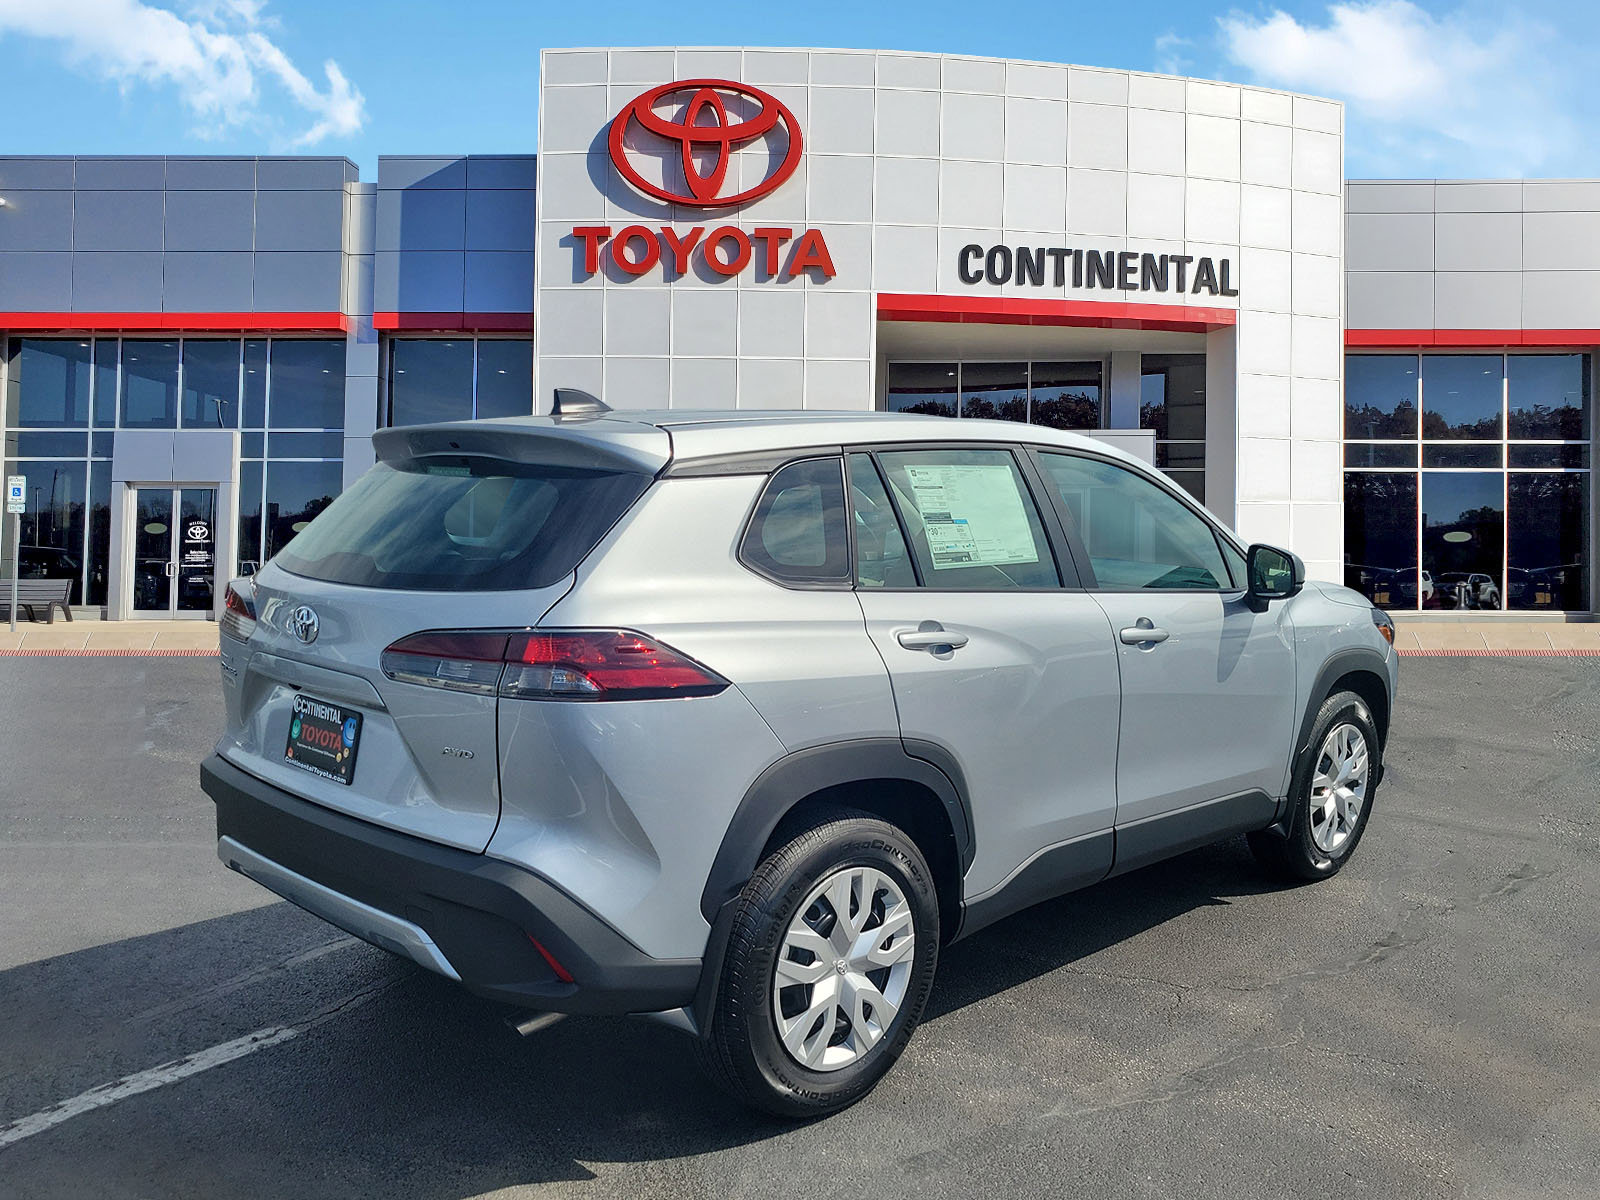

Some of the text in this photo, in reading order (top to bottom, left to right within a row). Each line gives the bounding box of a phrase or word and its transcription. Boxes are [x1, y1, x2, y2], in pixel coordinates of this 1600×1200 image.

[572, 225, 837, 277] TOYOTA
[959, 244, 1239, 296] CONTINENTAL
[301, 723, 342, 751] TOYOTA
[285, 756, 347, 784] ContinentalToyota.com
